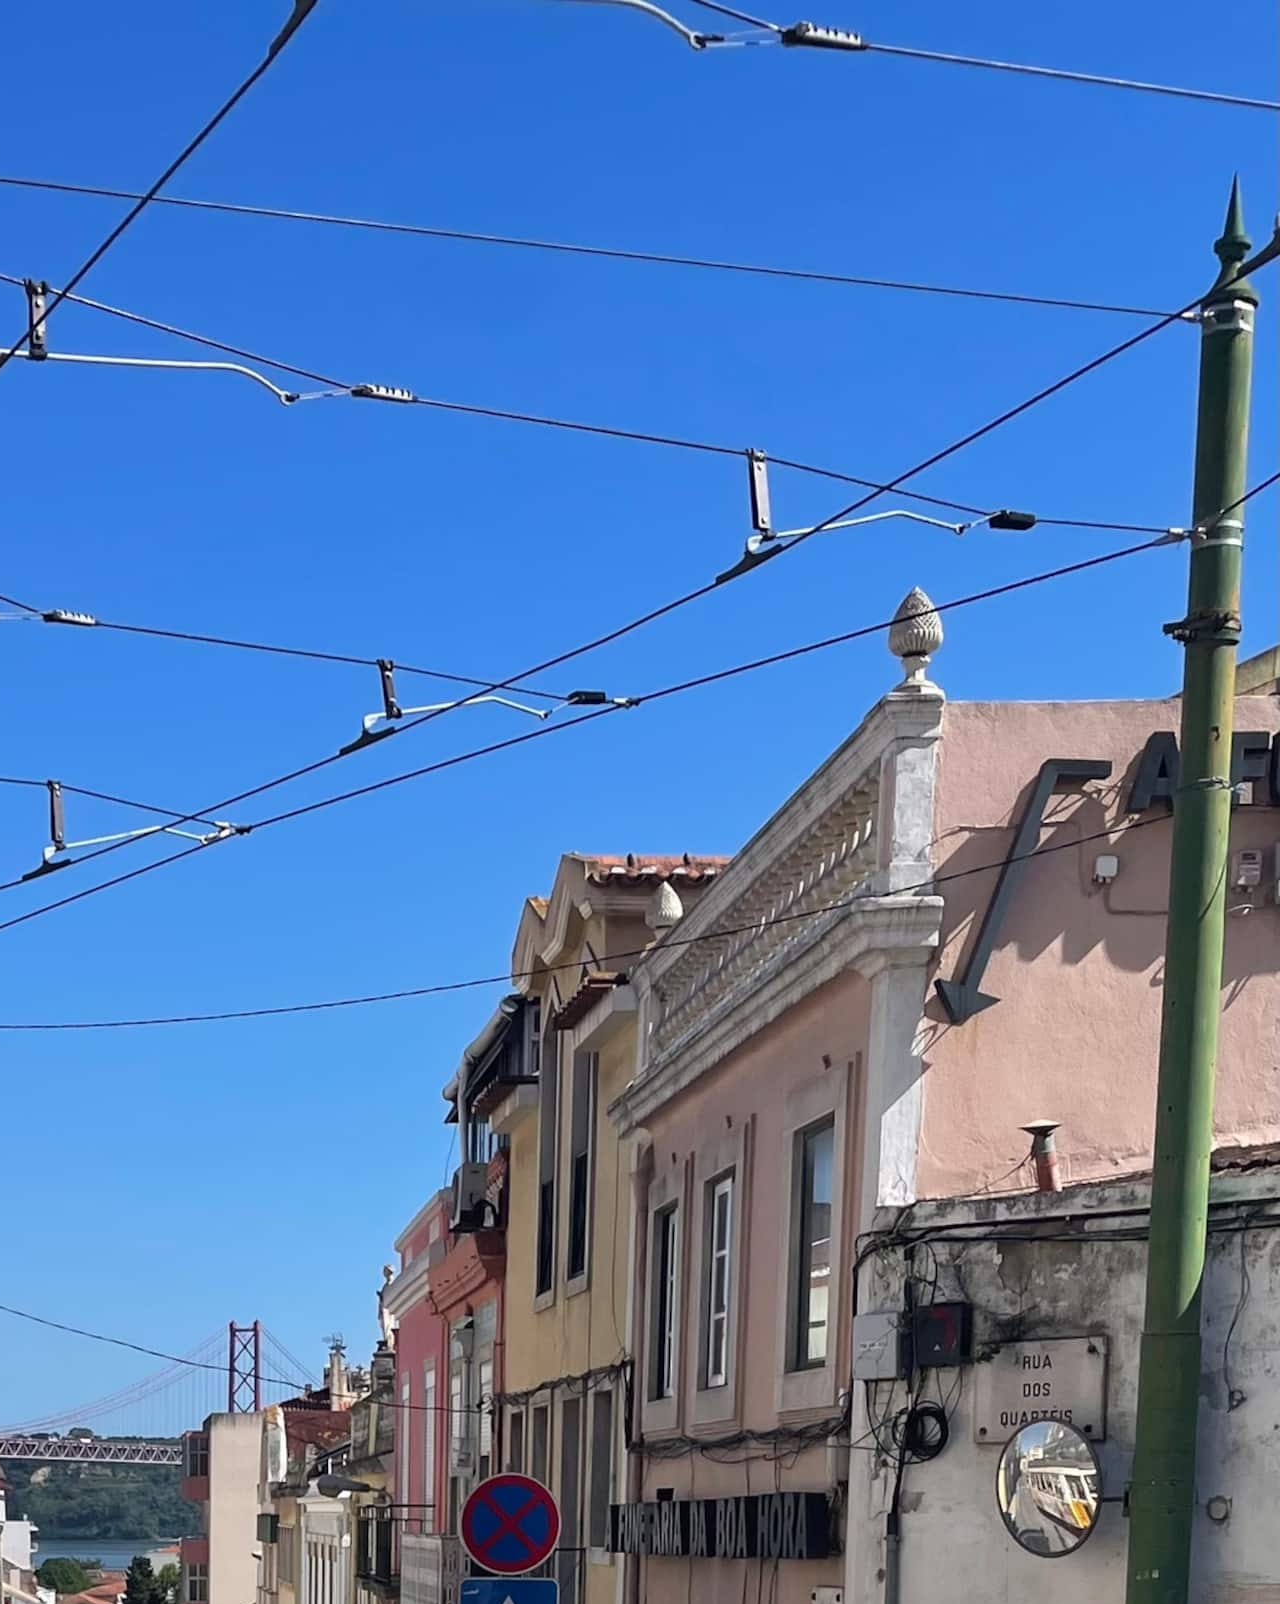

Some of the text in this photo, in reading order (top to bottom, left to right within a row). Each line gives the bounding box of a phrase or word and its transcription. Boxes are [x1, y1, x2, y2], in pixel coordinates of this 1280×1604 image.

[1022, 1355, 1052, 1369] RUA
[1023, 1382, 1051, 1398] DOS
[690, 1499, 708, 1558] DA
[716, 1496, 748, 1559] BOA
[757, 1492, 808, 1560] HORA
